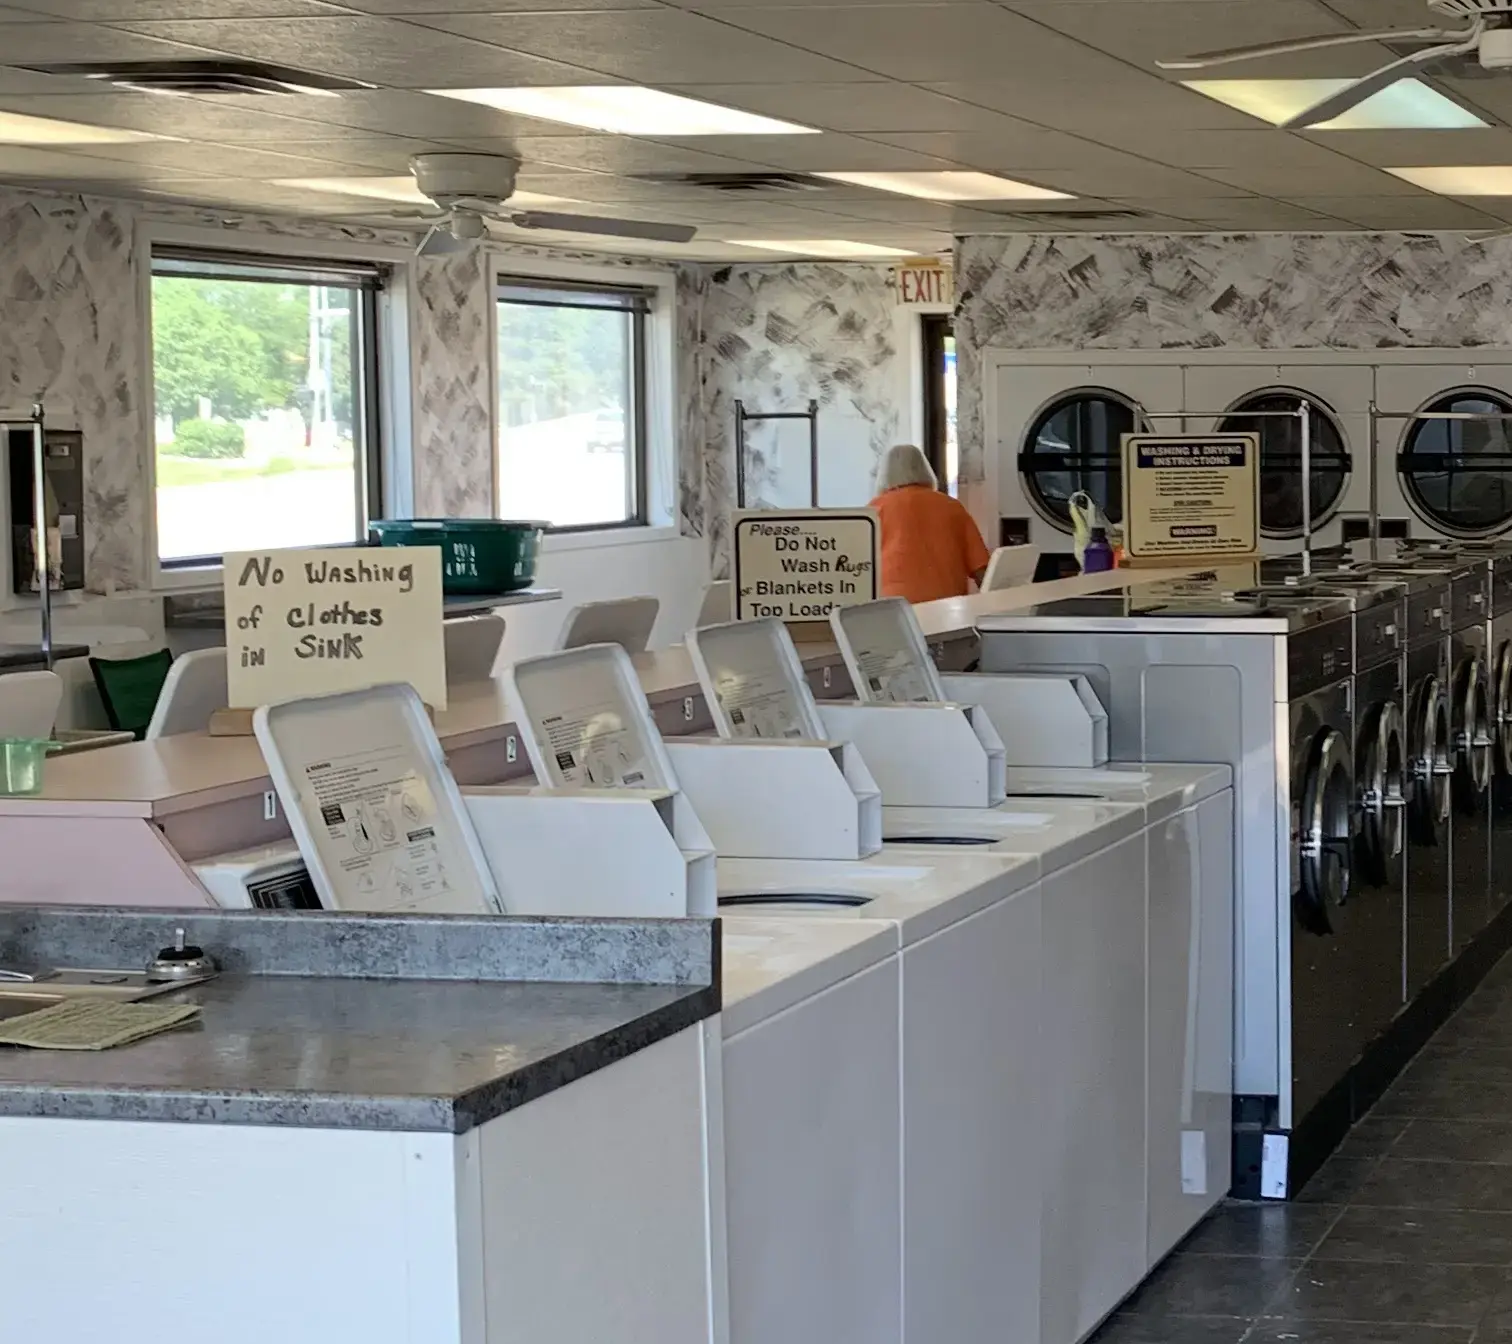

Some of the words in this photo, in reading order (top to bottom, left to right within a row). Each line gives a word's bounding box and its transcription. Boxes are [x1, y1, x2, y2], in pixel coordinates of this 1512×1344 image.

[901, 270, 944, 302] EXIT
[1140, 446, 1190, 456] WASHING
[1192, 446, 1200, 456] &
[1202, 445, 1243, 455] DRYING
[1152, 456, 1231, 466] INSTRUCTIONS
[775, 537, 799, 551] Do
[805, 536, 837, 551] Not
[238, 556, 284, 587] No
[781, 558, 830, 573] Wash
[834, 554, 872, 577] Rugs
[756, 580, 834, 595] Blankets
[839, 580, 856, 594] In
[237, 604, 264, 630] of
[750, 602, 783, 617] Top
[789, 601, 841, 617] Load
